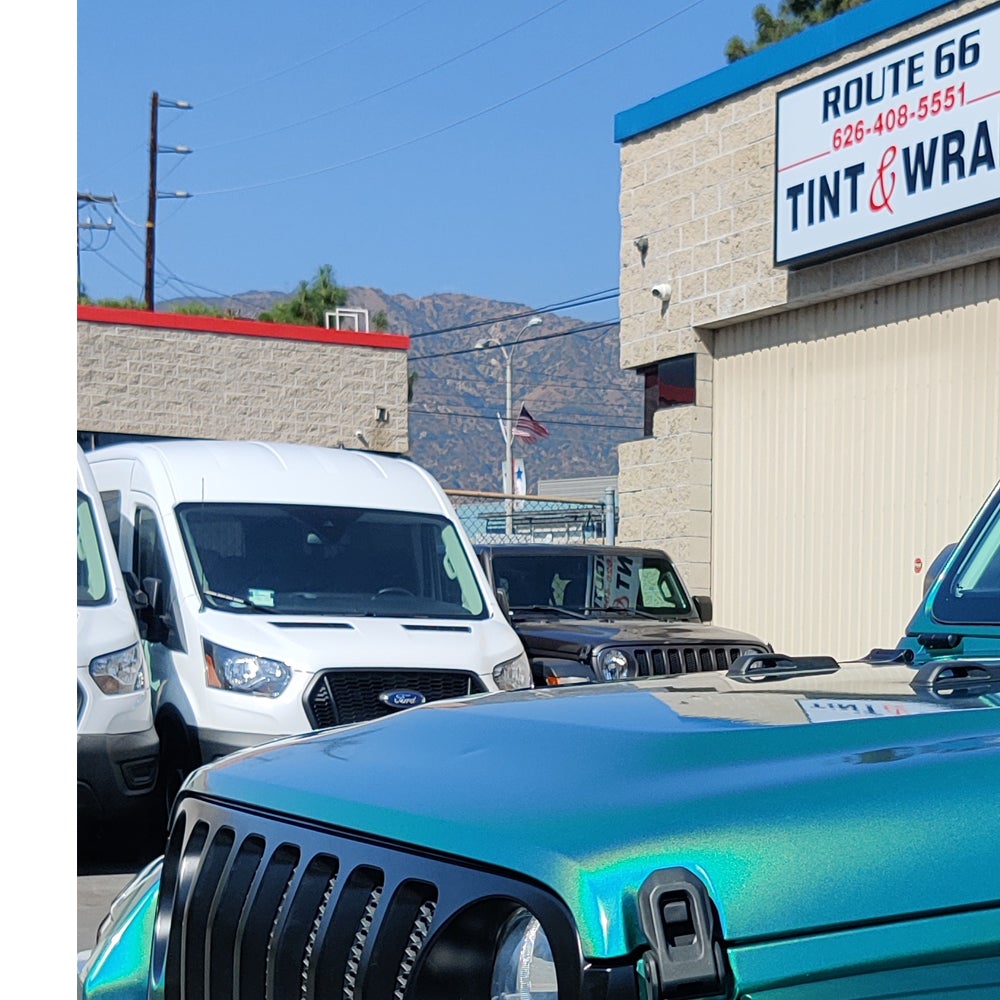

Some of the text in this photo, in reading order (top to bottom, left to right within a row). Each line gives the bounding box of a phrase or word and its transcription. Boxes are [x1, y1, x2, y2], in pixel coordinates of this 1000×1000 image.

[821, 29, 981, 124] ROUTE 66
[832, 82, 967, 150] 626-408-5551
[786, 162, 865, 232] TINT
[869, 145, 897, 214] &
[393, 694, 417, 704] Ford
